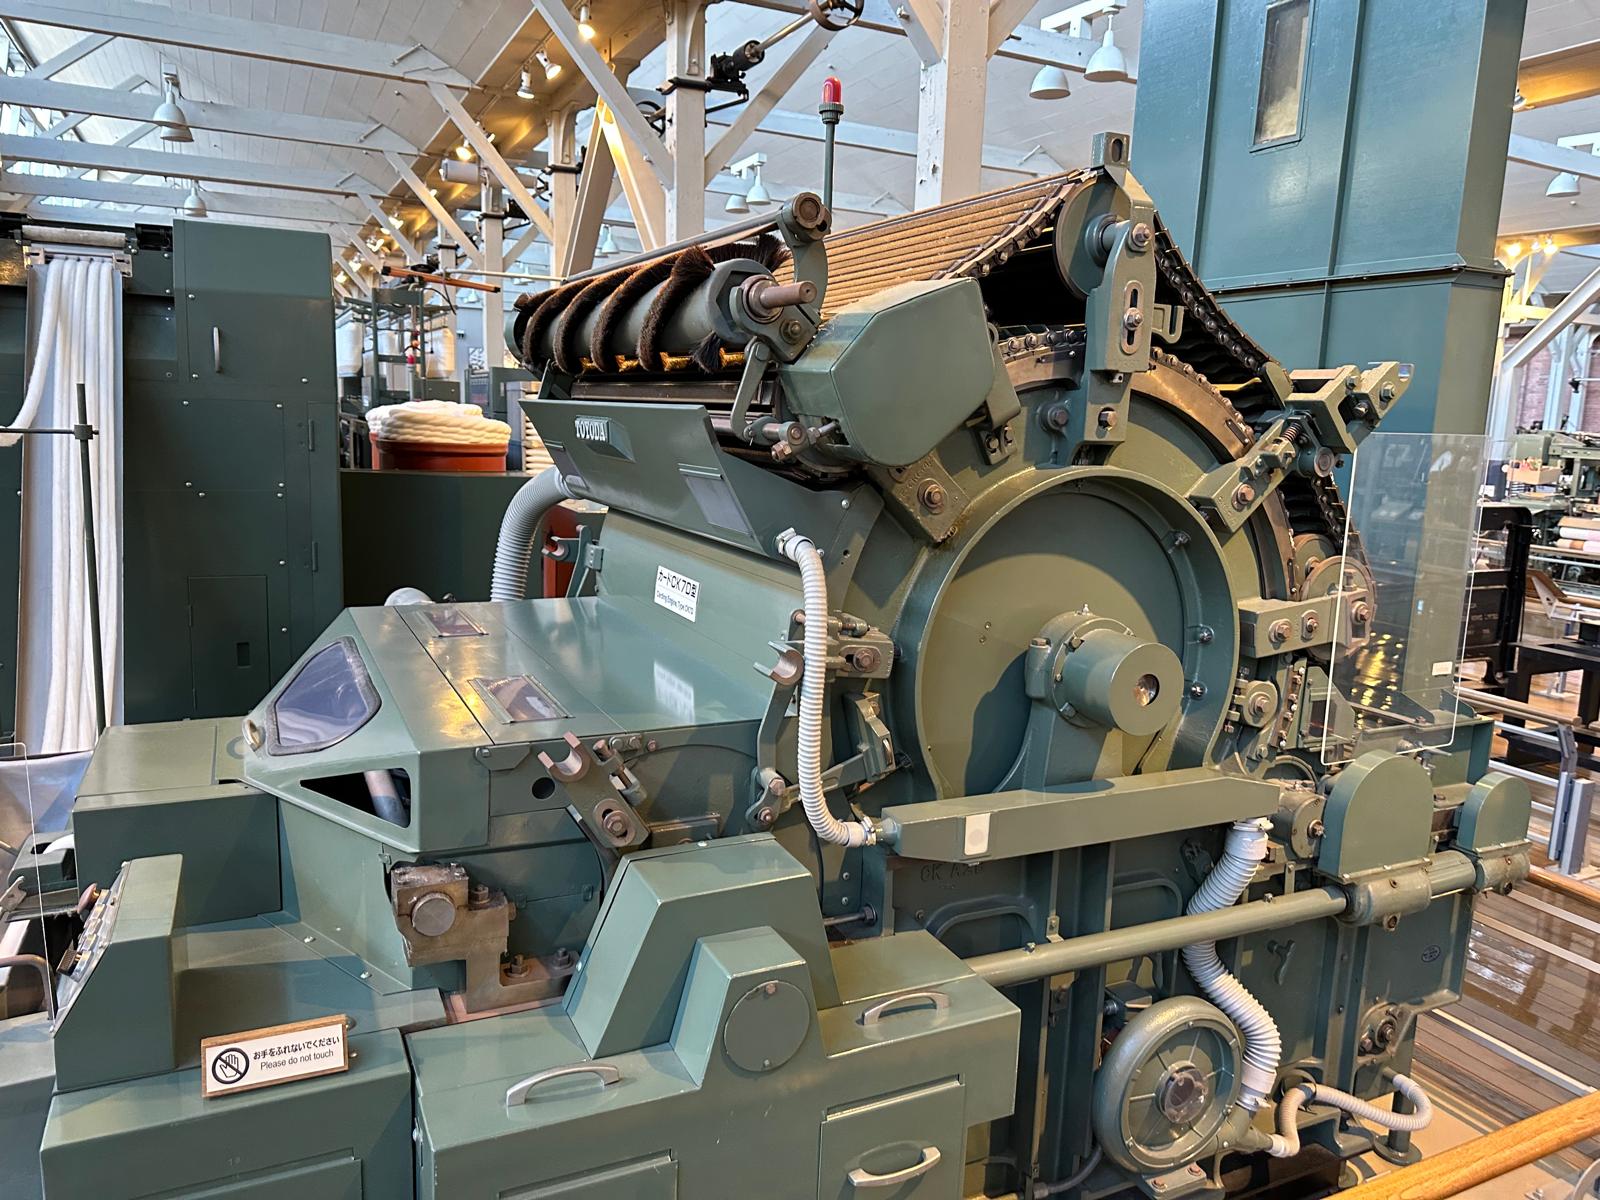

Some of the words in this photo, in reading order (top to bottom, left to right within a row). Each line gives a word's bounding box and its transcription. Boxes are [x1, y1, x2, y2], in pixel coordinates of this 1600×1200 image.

[574, 420, 606, 442] TOYODA
[253, 1036, 340, 1060] お手をふれないでください
[260, 1059, 287, 1071] Please
[287, 1055, 299, 1065] do
[299, 1053, 312, 1064] not
[313, 1048, 334, 1061] touch
